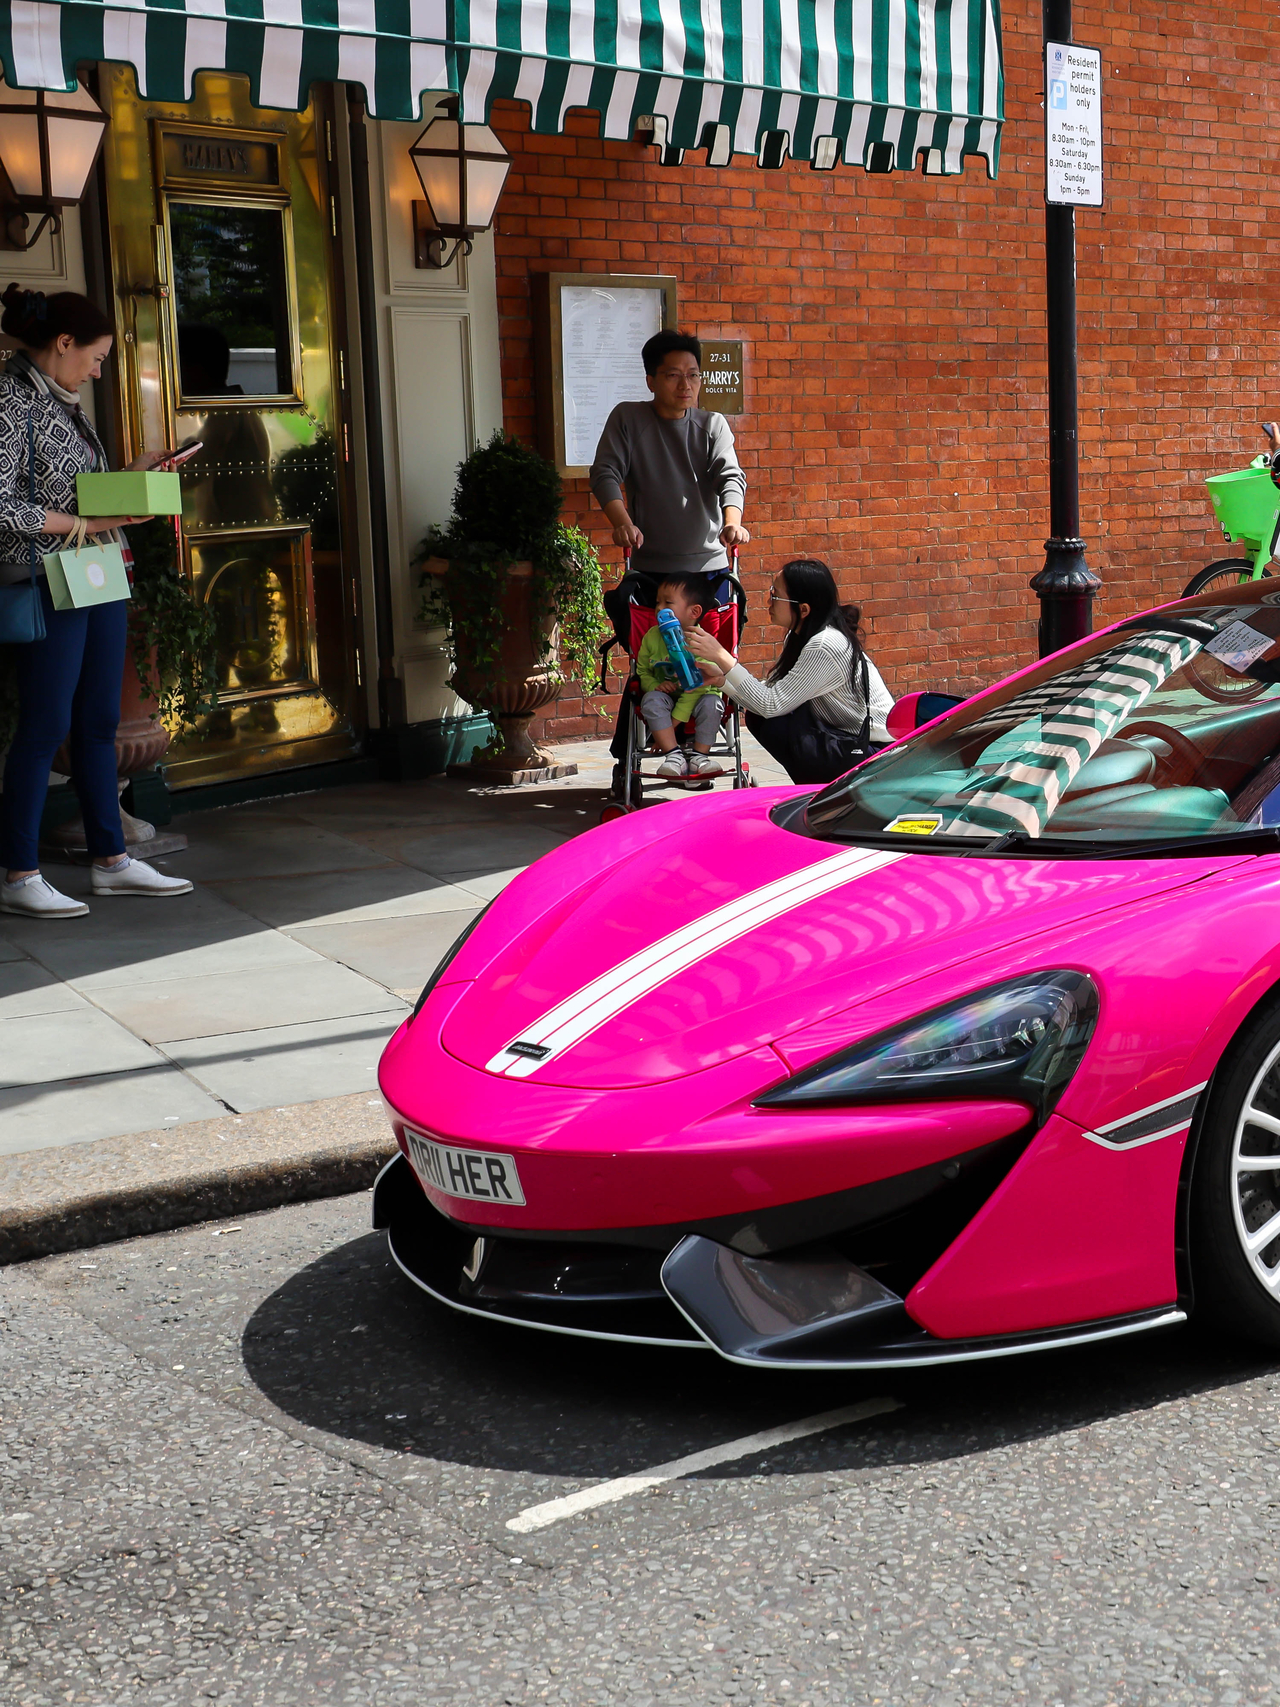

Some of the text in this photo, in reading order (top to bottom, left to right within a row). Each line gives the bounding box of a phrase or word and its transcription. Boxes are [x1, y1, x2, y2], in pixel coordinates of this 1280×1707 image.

[1067, 55, 1098, 69] Resident
[1071, 71, 1094, 81] permit
[1069, 82, 1096, 96] holders
[1076, 98, 1091, 109] only
[1061, 122, 1074, 131] Mon
[1051, 133, 1075, 144] 8.30am
[1080, 137, 1096, 147] 10pm
[1061, 147, 1088, 160] Saturday
[1049, 158, 1073, 169] 8.30am
[1077, 161, 1100, 172] 6.30pm
[1064, 172, 1086, 184] Sunday
[1059, 184, 1072, 196] 1pm
[1077, 186, 1090, 197] 5pm
[709, 353, 731, 363] 27-31
[702, 370, 740, 385] HARRY'S
[445, 1151, 513, 1199] HER
